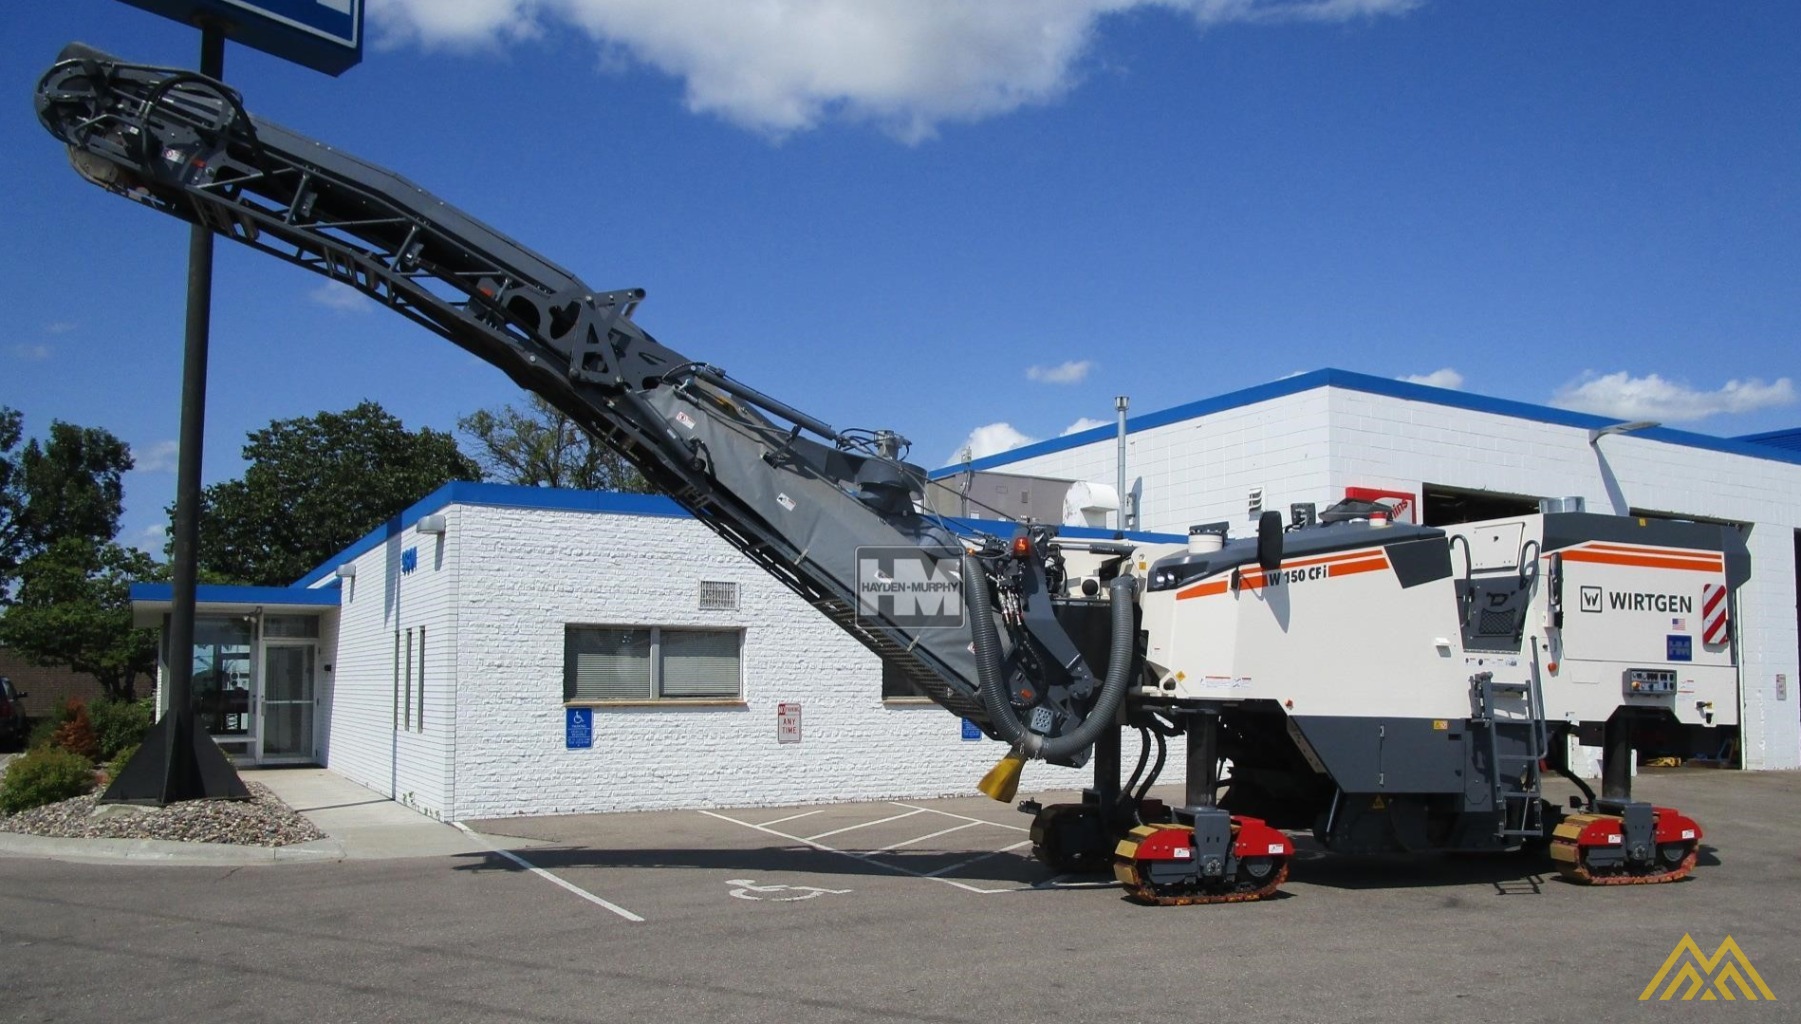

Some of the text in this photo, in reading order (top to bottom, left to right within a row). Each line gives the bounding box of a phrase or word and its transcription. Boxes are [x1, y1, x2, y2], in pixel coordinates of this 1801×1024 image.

[1268, 572, 1281, 587] W
[1284, 569, 1306, 584] 150
[1609, 591, 1692, 613] WIRTGEN
[782, 726, 797, 734] TIME
